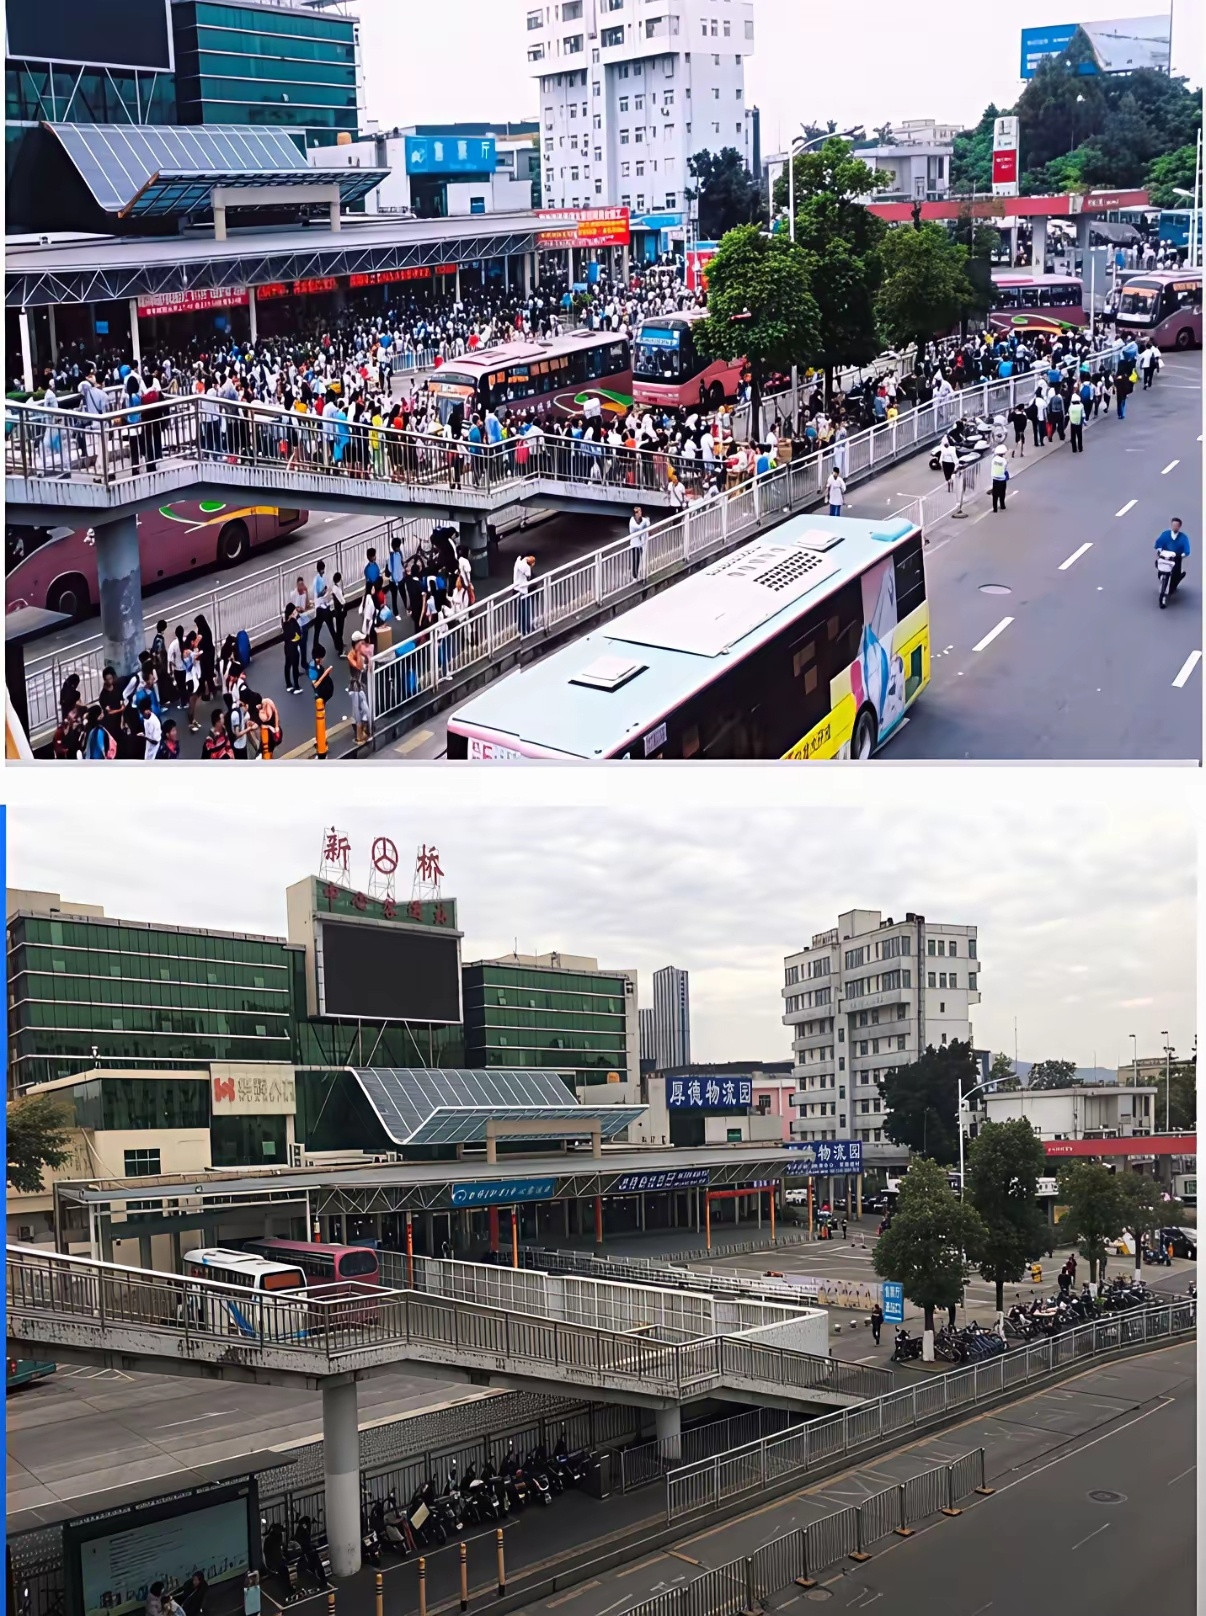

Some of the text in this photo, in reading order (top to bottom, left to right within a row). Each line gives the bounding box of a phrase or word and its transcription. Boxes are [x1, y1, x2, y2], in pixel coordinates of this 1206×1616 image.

[324, 826, 444, 886] 新 桥
[670, 1080, 751, 1106] 厚德物流园
[789, 1143, 860, 1161] 物流园
